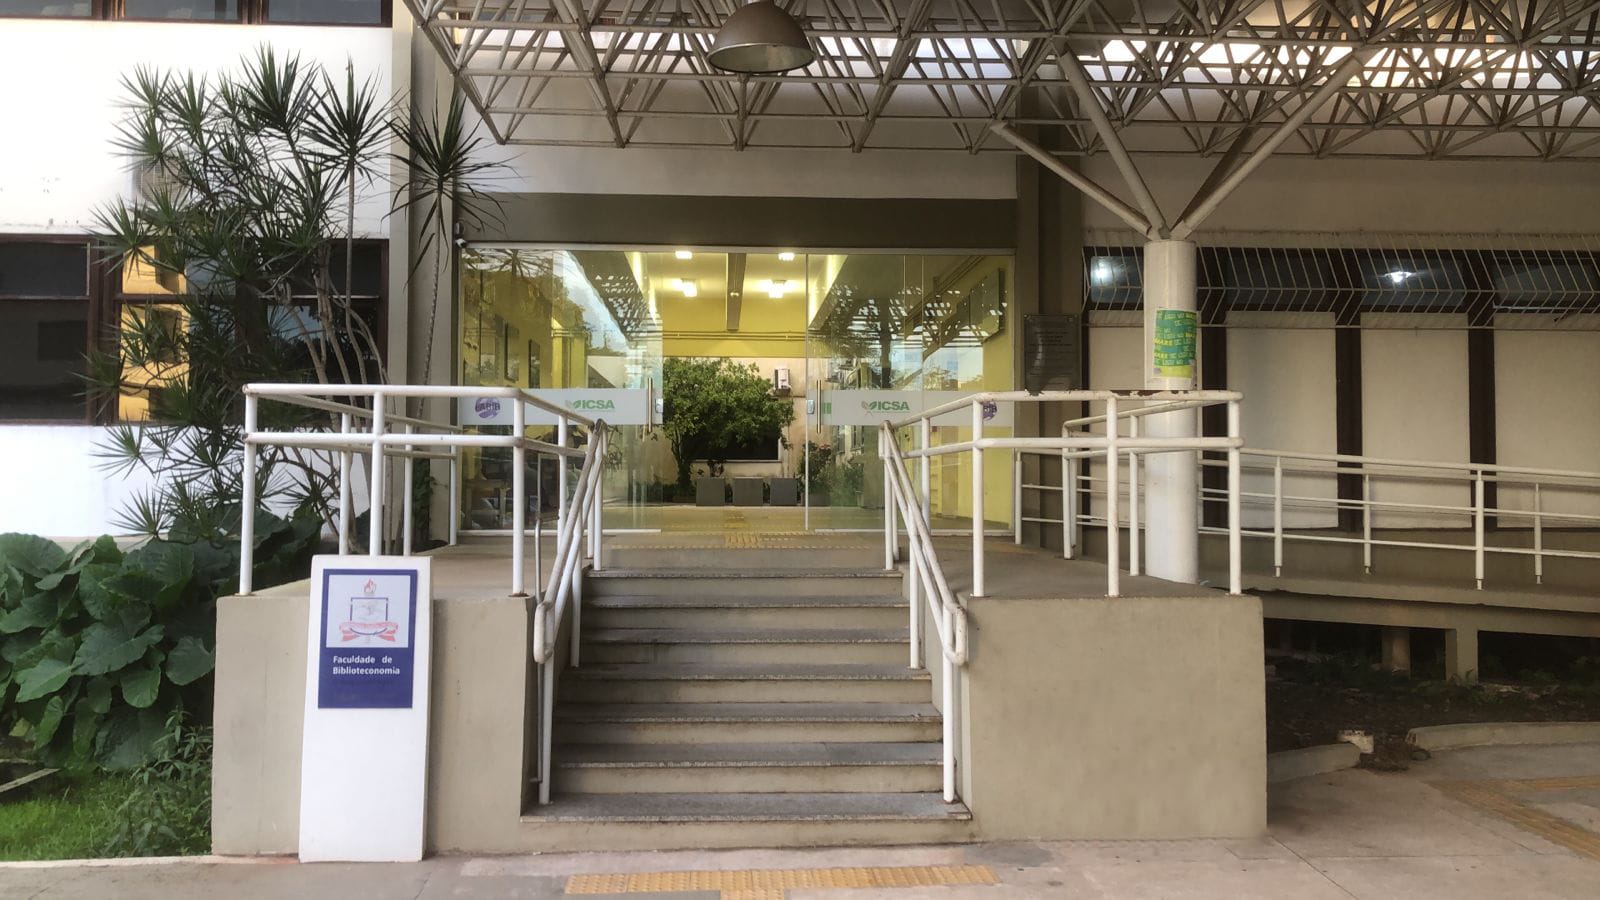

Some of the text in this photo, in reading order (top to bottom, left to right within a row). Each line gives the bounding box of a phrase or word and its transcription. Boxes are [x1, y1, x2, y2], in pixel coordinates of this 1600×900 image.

[582, 399, 615, 410] ICSA
[877, 401, 910, 411] ICSA
[333, 655, 393, 664] Faculdade de
[332, 666, 401, 675] Biblioteconomia
